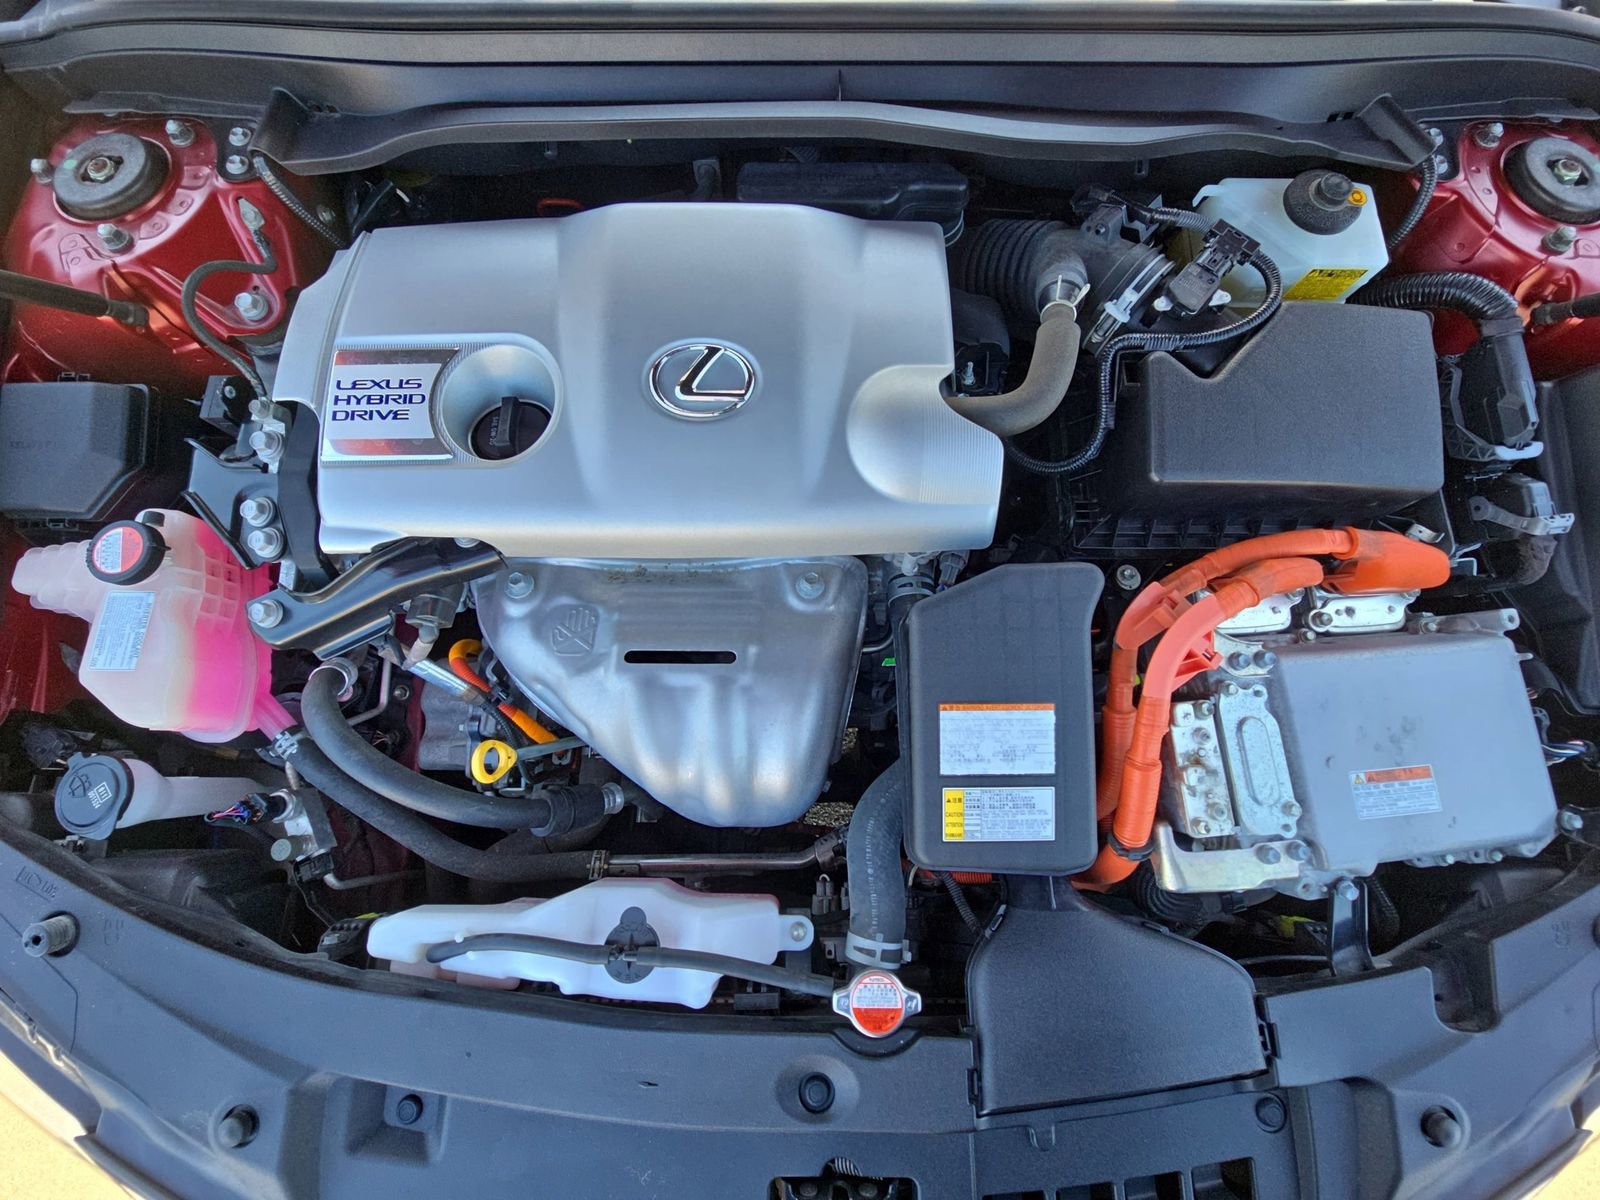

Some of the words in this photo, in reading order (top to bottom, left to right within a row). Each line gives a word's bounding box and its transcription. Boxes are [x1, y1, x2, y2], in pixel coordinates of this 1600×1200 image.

[335, 378, 422, 390] LEXUS
[333, 393, 426, 406] HYBRID
[331, 409, 410, 421] DRIVE
